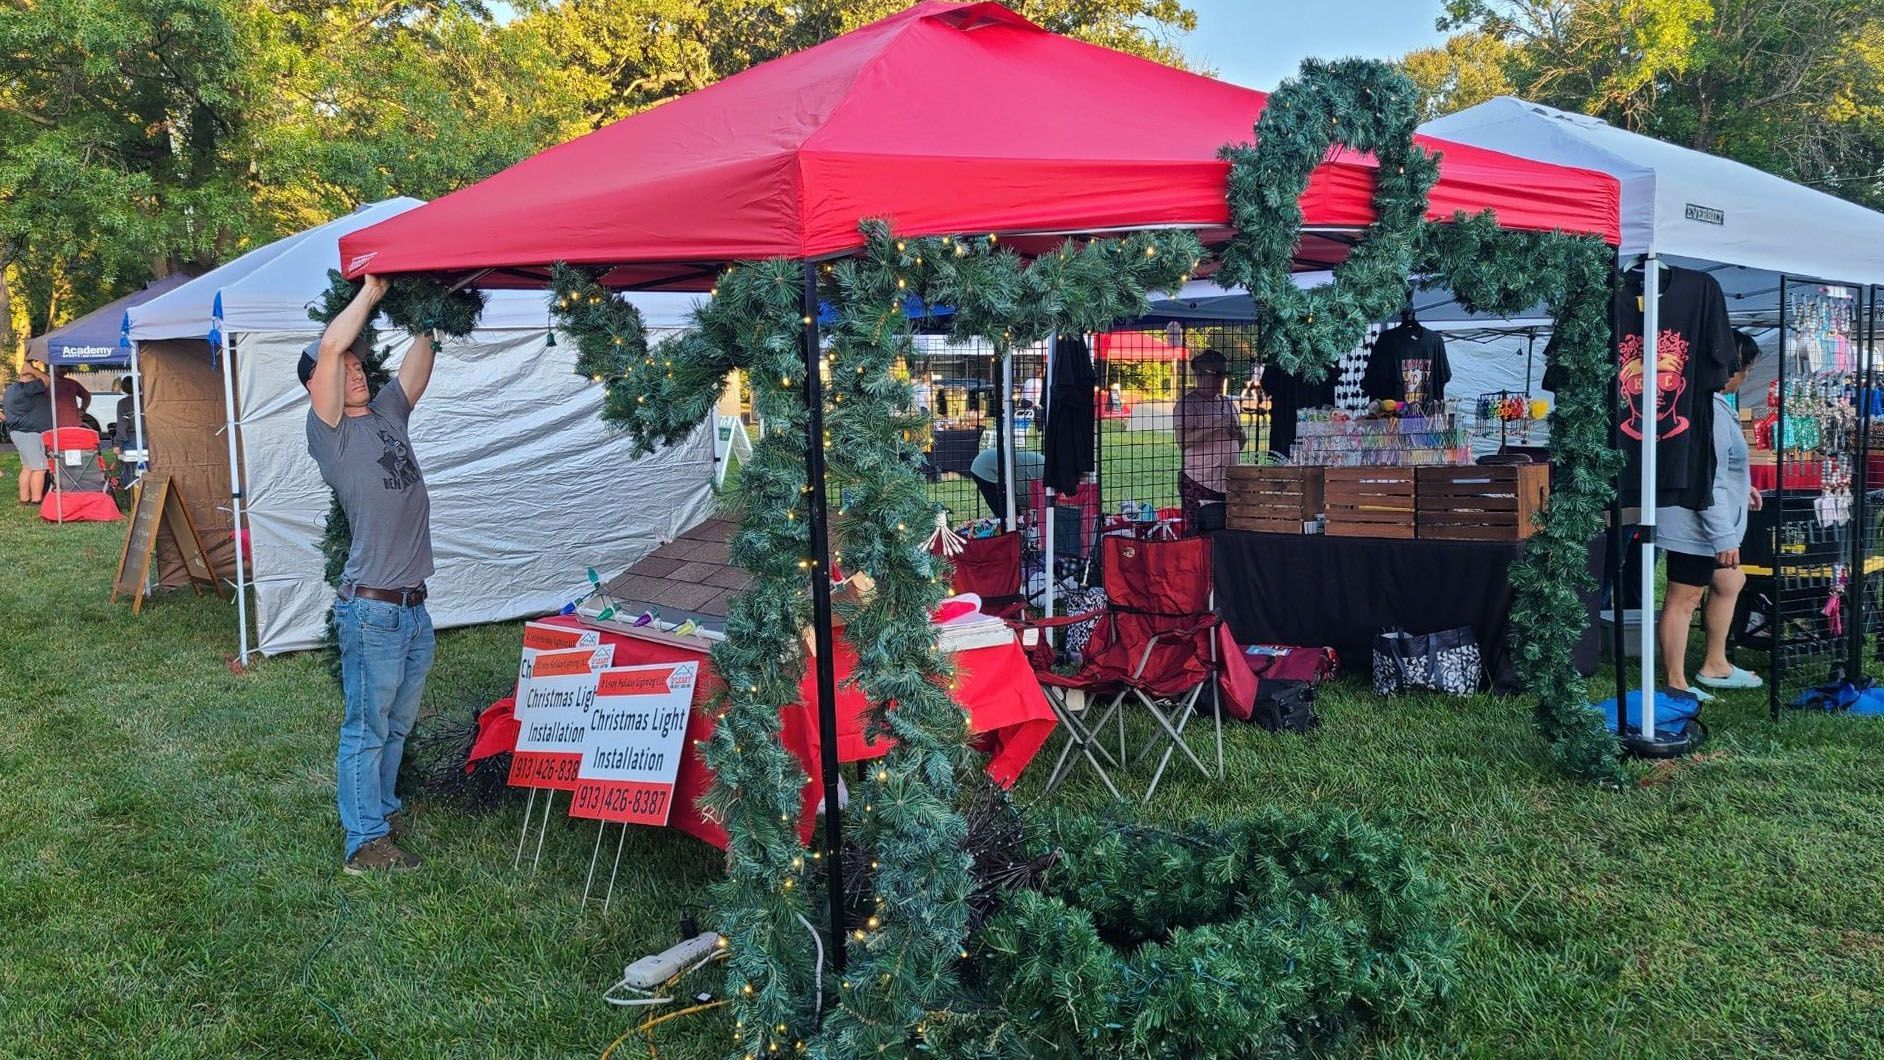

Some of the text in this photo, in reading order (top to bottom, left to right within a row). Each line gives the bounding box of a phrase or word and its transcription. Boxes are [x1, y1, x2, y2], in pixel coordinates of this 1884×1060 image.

[63, 346, 112, 357] Academy
[527, 687, 574, 708] Christmas
[528, 722, 585, 743] Installation
[590, 707, 685, 738] Christmas Light
[511, 757, 580, 785] (913)426-838
[593, 746, 664, 771] Installation
[573, 784, 667, 816] (913)426-8387
